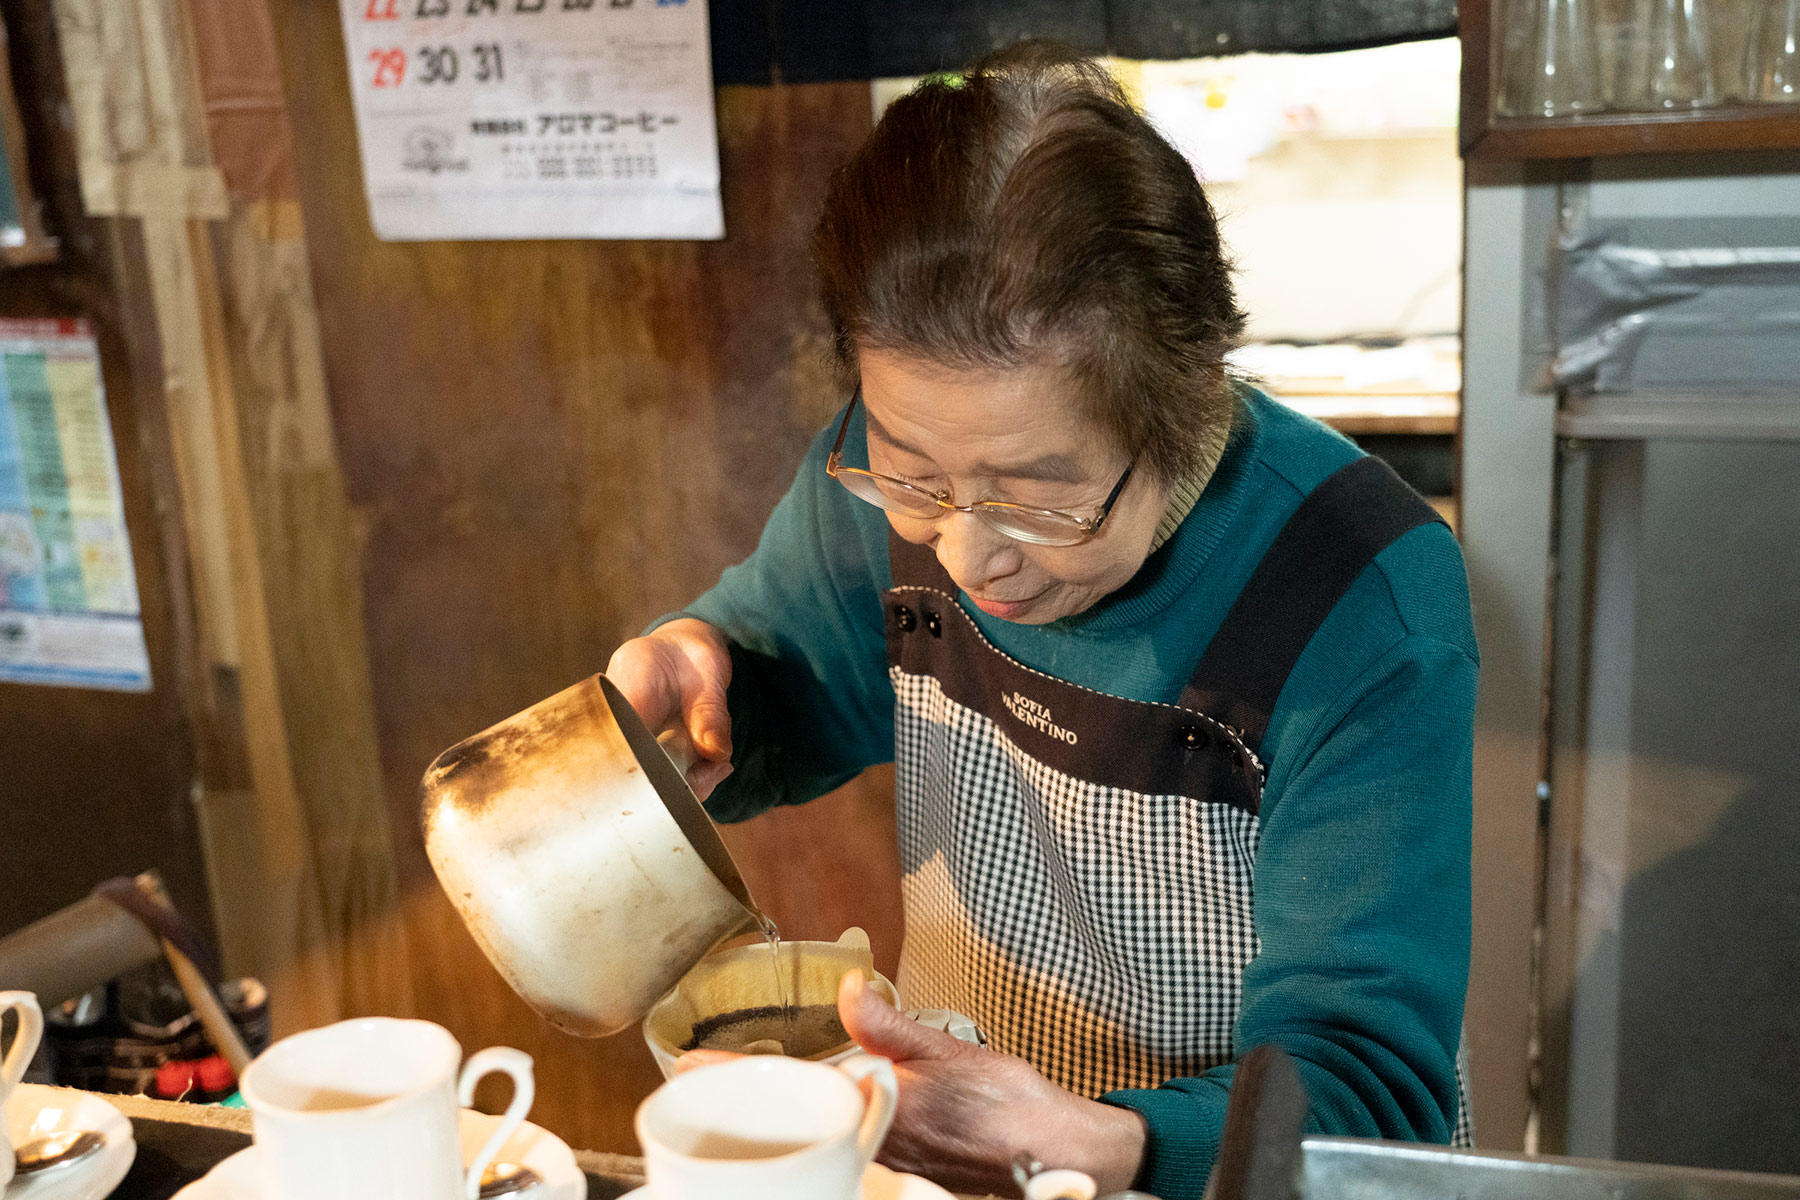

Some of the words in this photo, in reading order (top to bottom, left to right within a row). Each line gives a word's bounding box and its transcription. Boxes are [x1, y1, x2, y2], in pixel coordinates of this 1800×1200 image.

[368, 48, 407, 88] 29
[417, 46, 459, 84] 30
[472, 44, 505, 82] 31
[1001, 691, 1078, 745] VALENTINO
[1013, 691, 1052, 721] SOFIA
